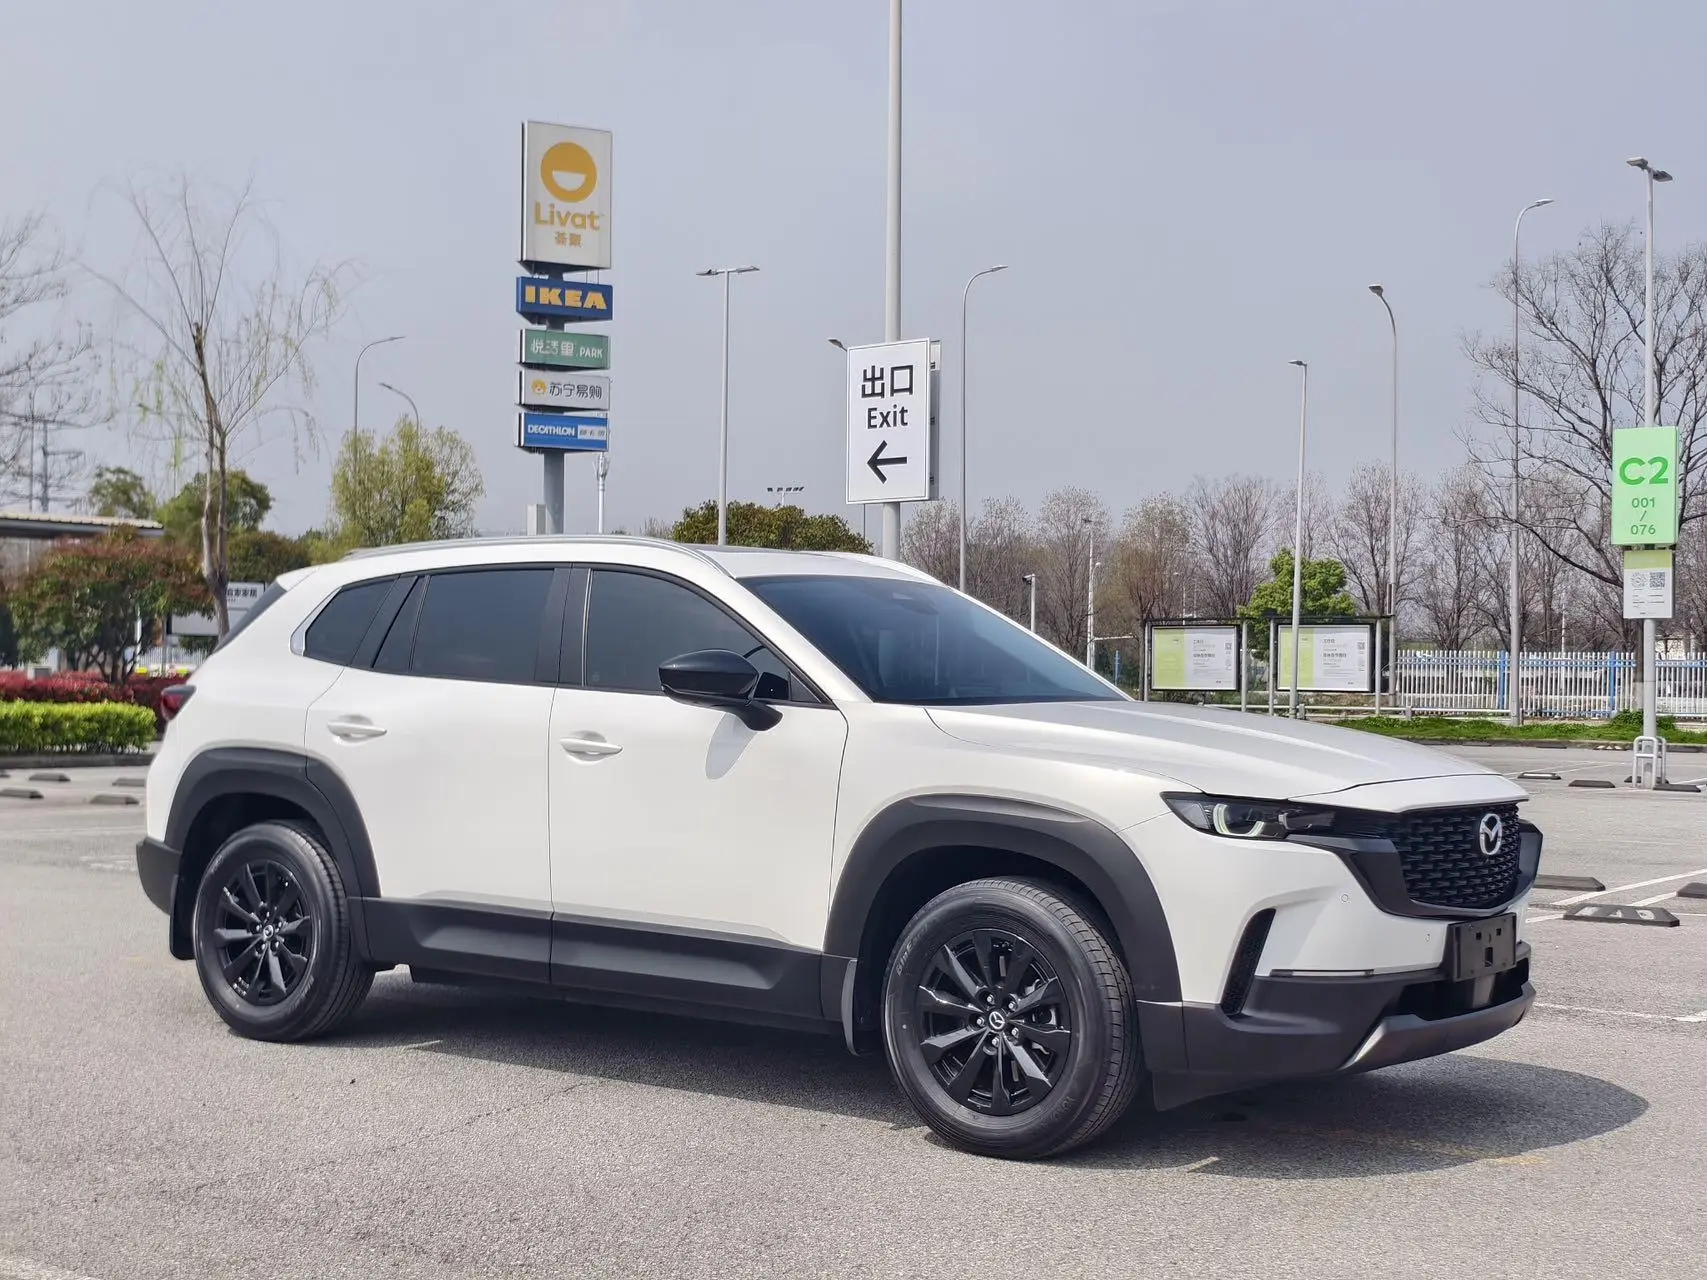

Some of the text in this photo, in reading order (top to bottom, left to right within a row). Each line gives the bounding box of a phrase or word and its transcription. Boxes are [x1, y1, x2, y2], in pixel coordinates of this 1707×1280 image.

[534, 201, 600, 231] Livat
[525, 285, 607, 310] IKEA
[579, 347, 603, 359] PARK
[549, 381, 602, 399] 苏宁易购
[861, 364, 914, 399] 出口
[867, 404, 909, 430] Exit
[527, 424, 576, 437] DECATHLON
[1619, 456, 1669, 486] C2
[1631, 497, 1656, 508] 001
[1630, 524, 1656, 535] 076
